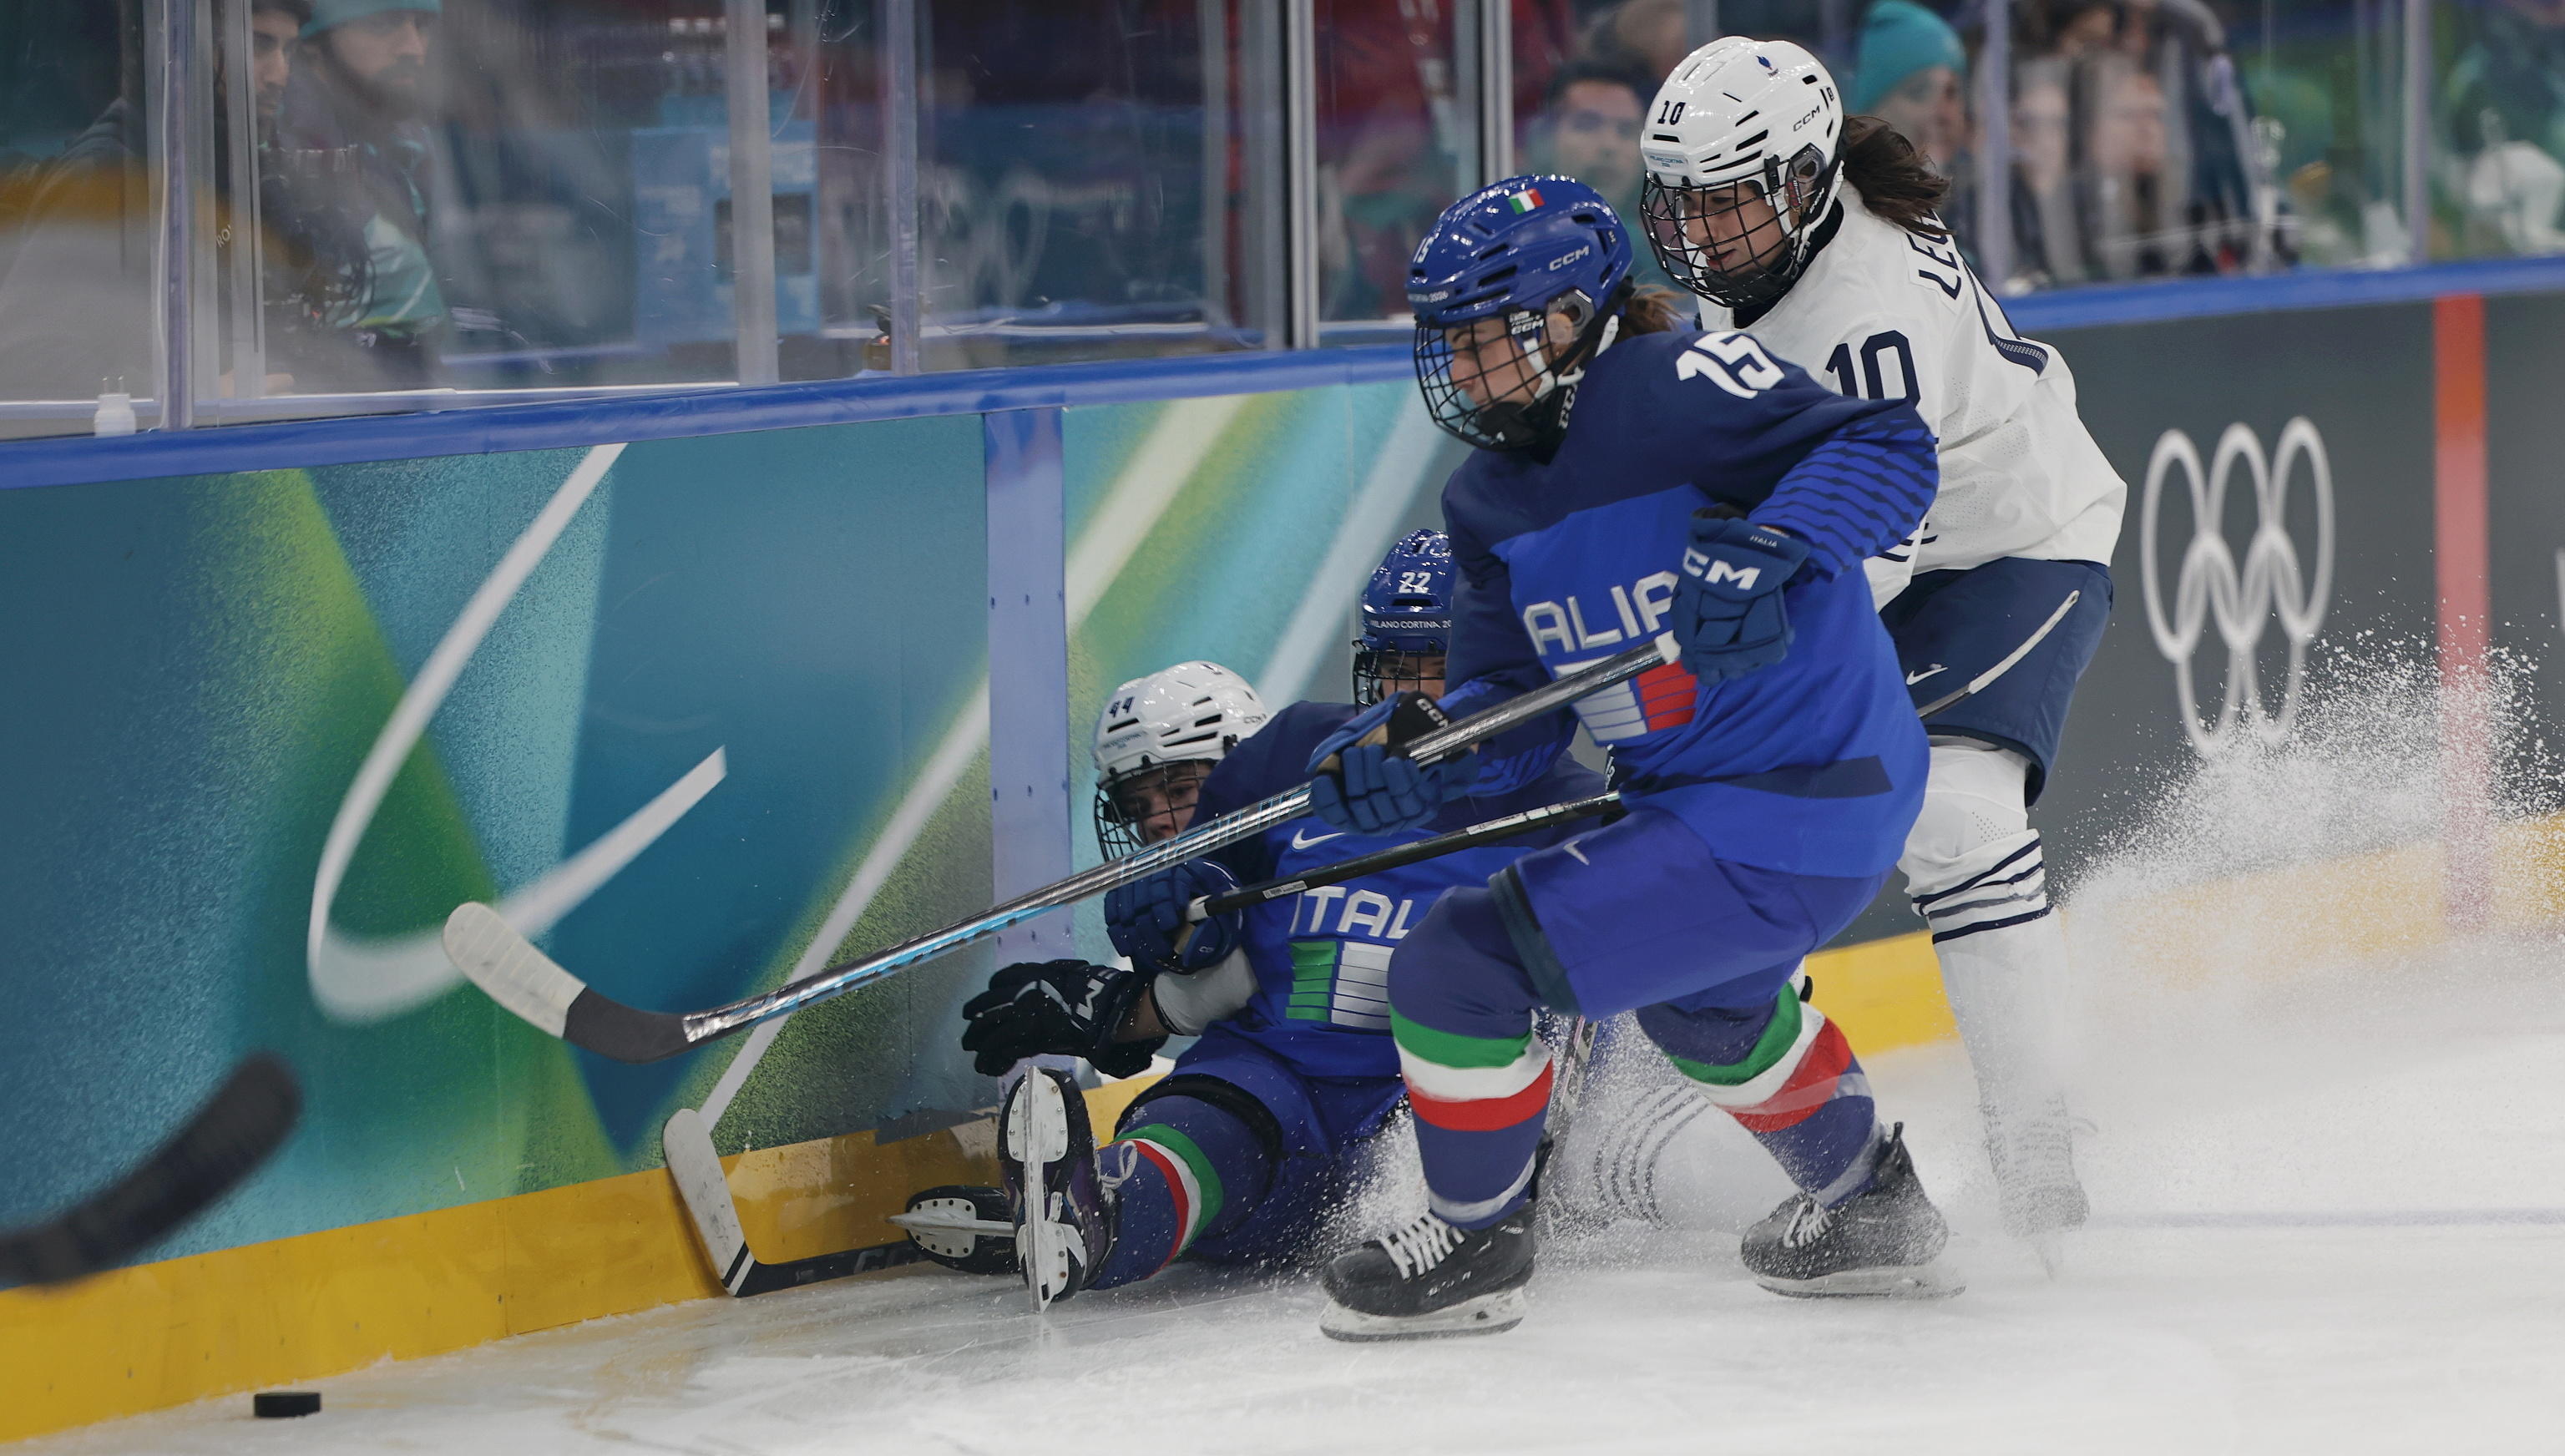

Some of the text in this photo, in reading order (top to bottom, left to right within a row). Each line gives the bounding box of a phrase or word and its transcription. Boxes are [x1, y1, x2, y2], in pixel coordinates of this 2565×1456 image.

[1657, 99, 1686, 125] 10
[1793, 105, 1820, 132] CCM
[1549, 245, 1590, 271] CCM
[1676, 331, 1785, 400] 15
[1825, 330, 1921, 408] 10
[1398, 572, 1431, 594] 22
[1400, 619, 1440, 629] CORTINA
